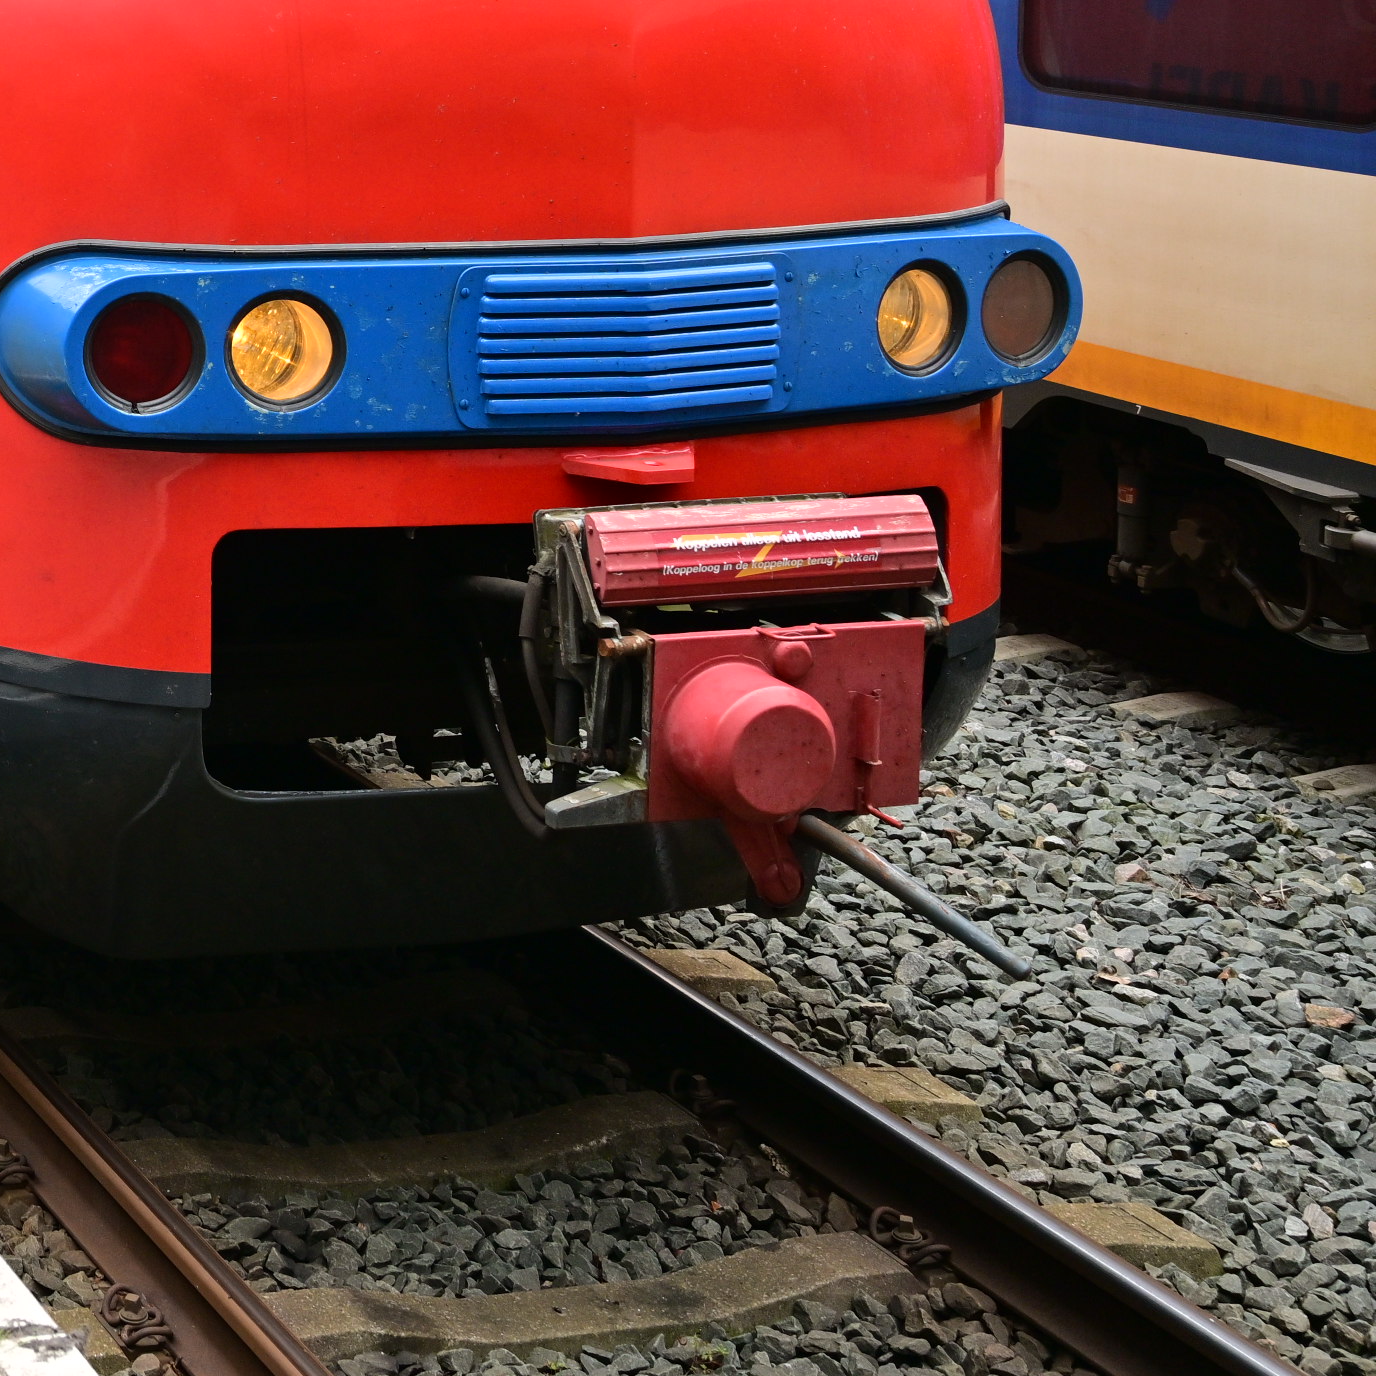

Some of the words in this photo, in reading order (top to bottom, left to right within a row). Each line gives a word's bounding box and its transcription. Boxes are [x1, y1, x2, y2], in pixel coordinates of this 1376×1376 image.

[1135, 404, 1142, 414] 7
[672, 534, 738, 552] Koppelen
[740, 532, 781, 546] alleen
[782, 530, 802, 543] uit
[803, 526, 861, 542] losstand
[662, 563, 721, 576] (Koppeloog
[723, 562, 733, 570] in
[735, 560, 749, 570] de
[751, 557, 804, 571] koppelkop
[807, 556, 834, 566] terug
